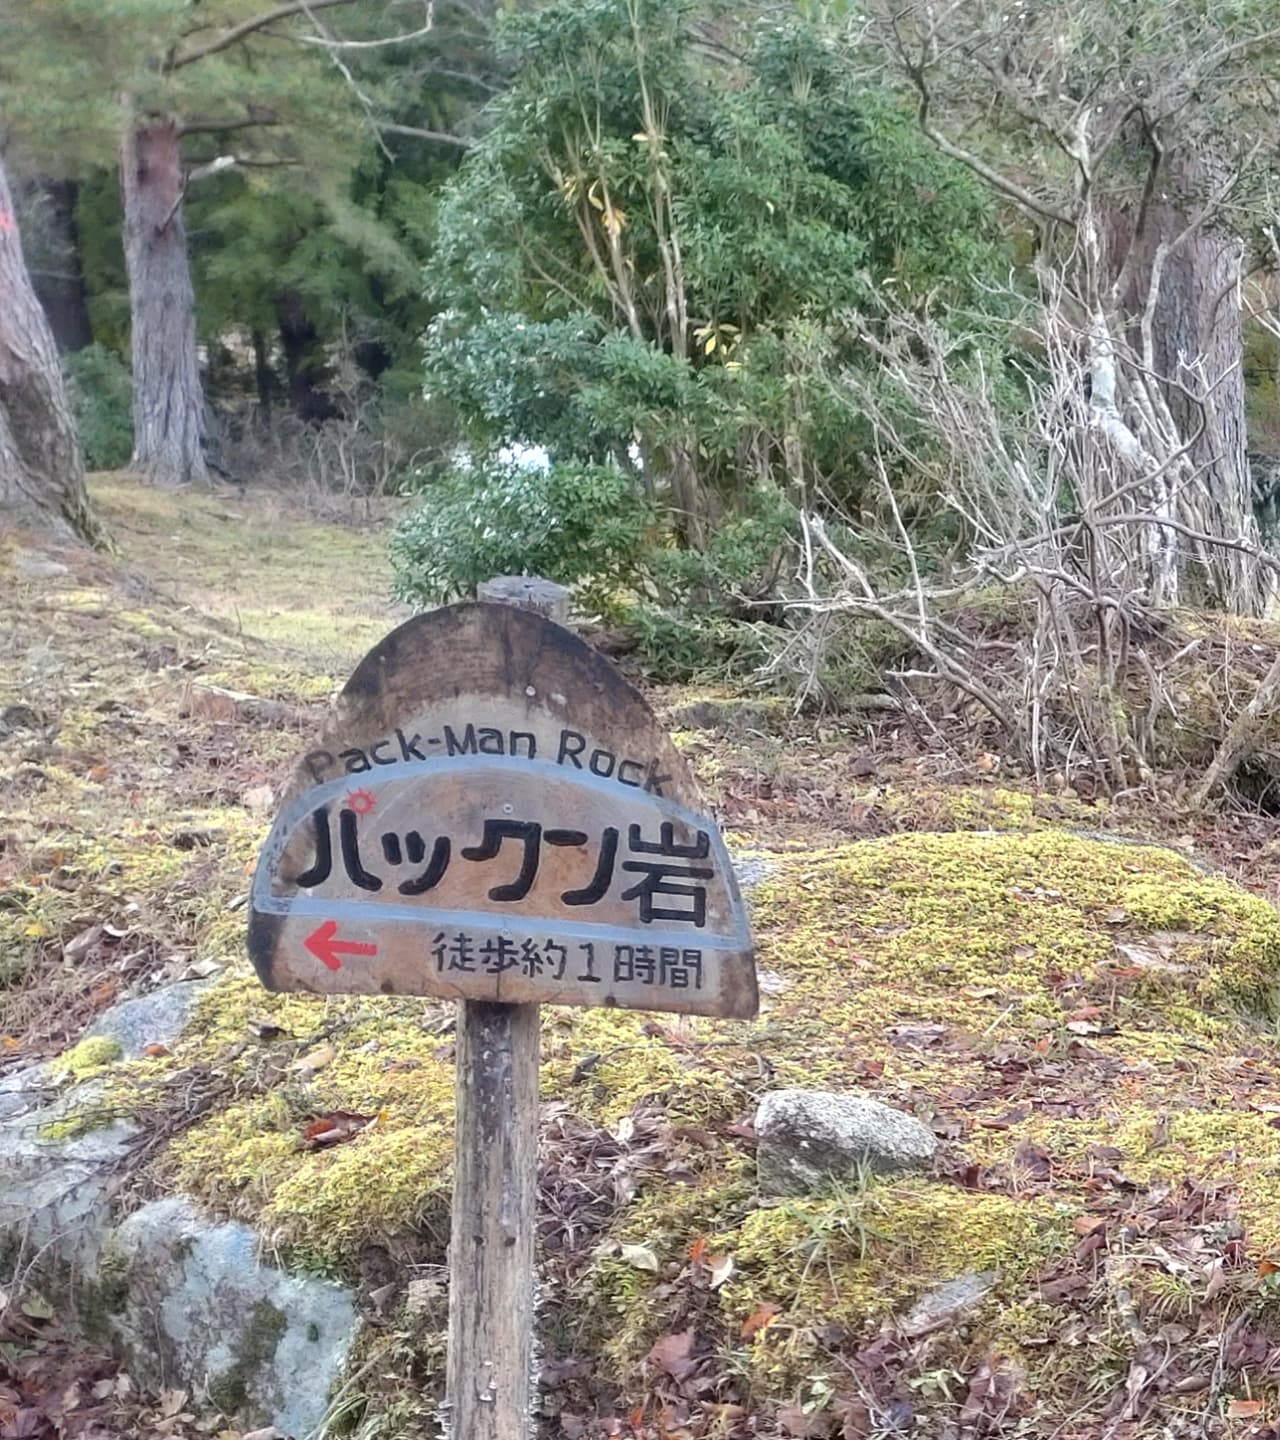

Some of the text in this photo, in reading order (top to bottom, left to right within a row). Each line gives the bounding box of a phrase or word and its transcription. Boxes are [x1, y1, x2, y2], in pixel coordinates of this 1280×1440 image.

[304, 723, 673, 796] Pack-Man Rock
[431, 932, 702, 990] 徒歩約1時間
